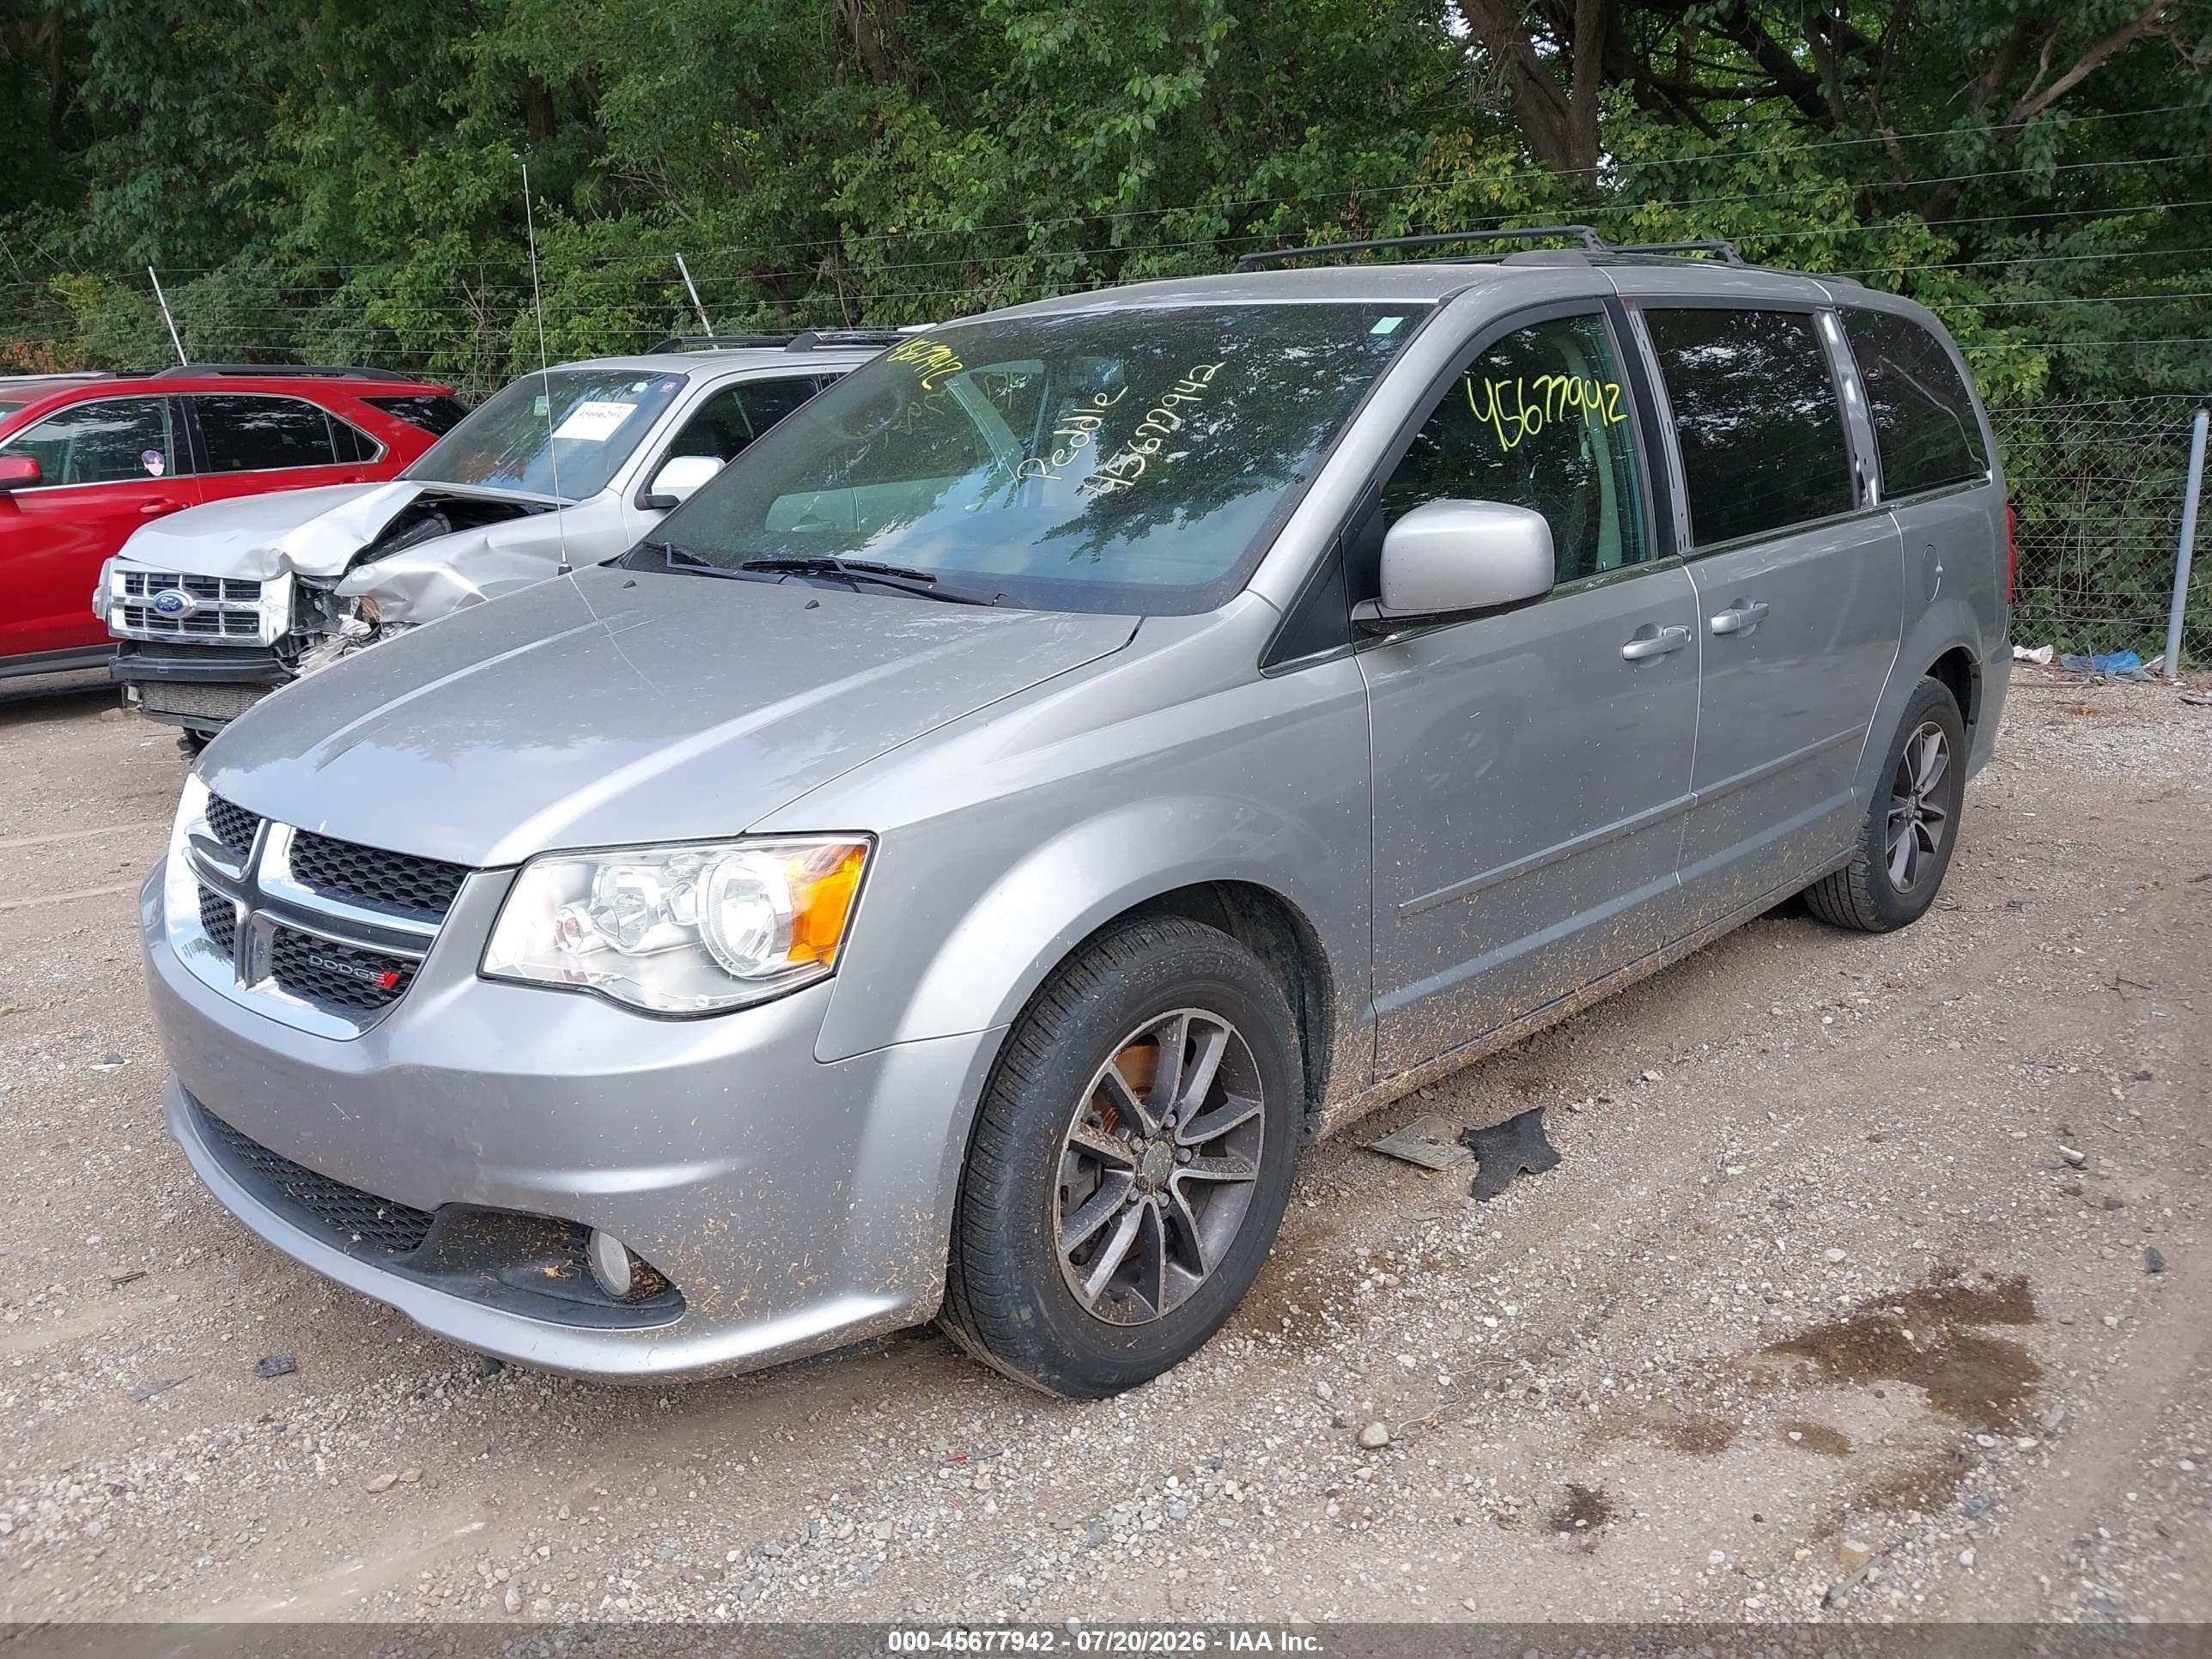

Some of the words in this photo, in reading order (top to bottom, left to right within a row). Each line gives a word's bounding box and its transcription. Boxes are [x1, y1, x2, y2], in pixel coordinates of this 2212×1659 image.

[1085, 362, 1226, 493] 45677942
[1467, 374, 1628, 452] 45677942
[308, 954, 386, 985] DODGE
